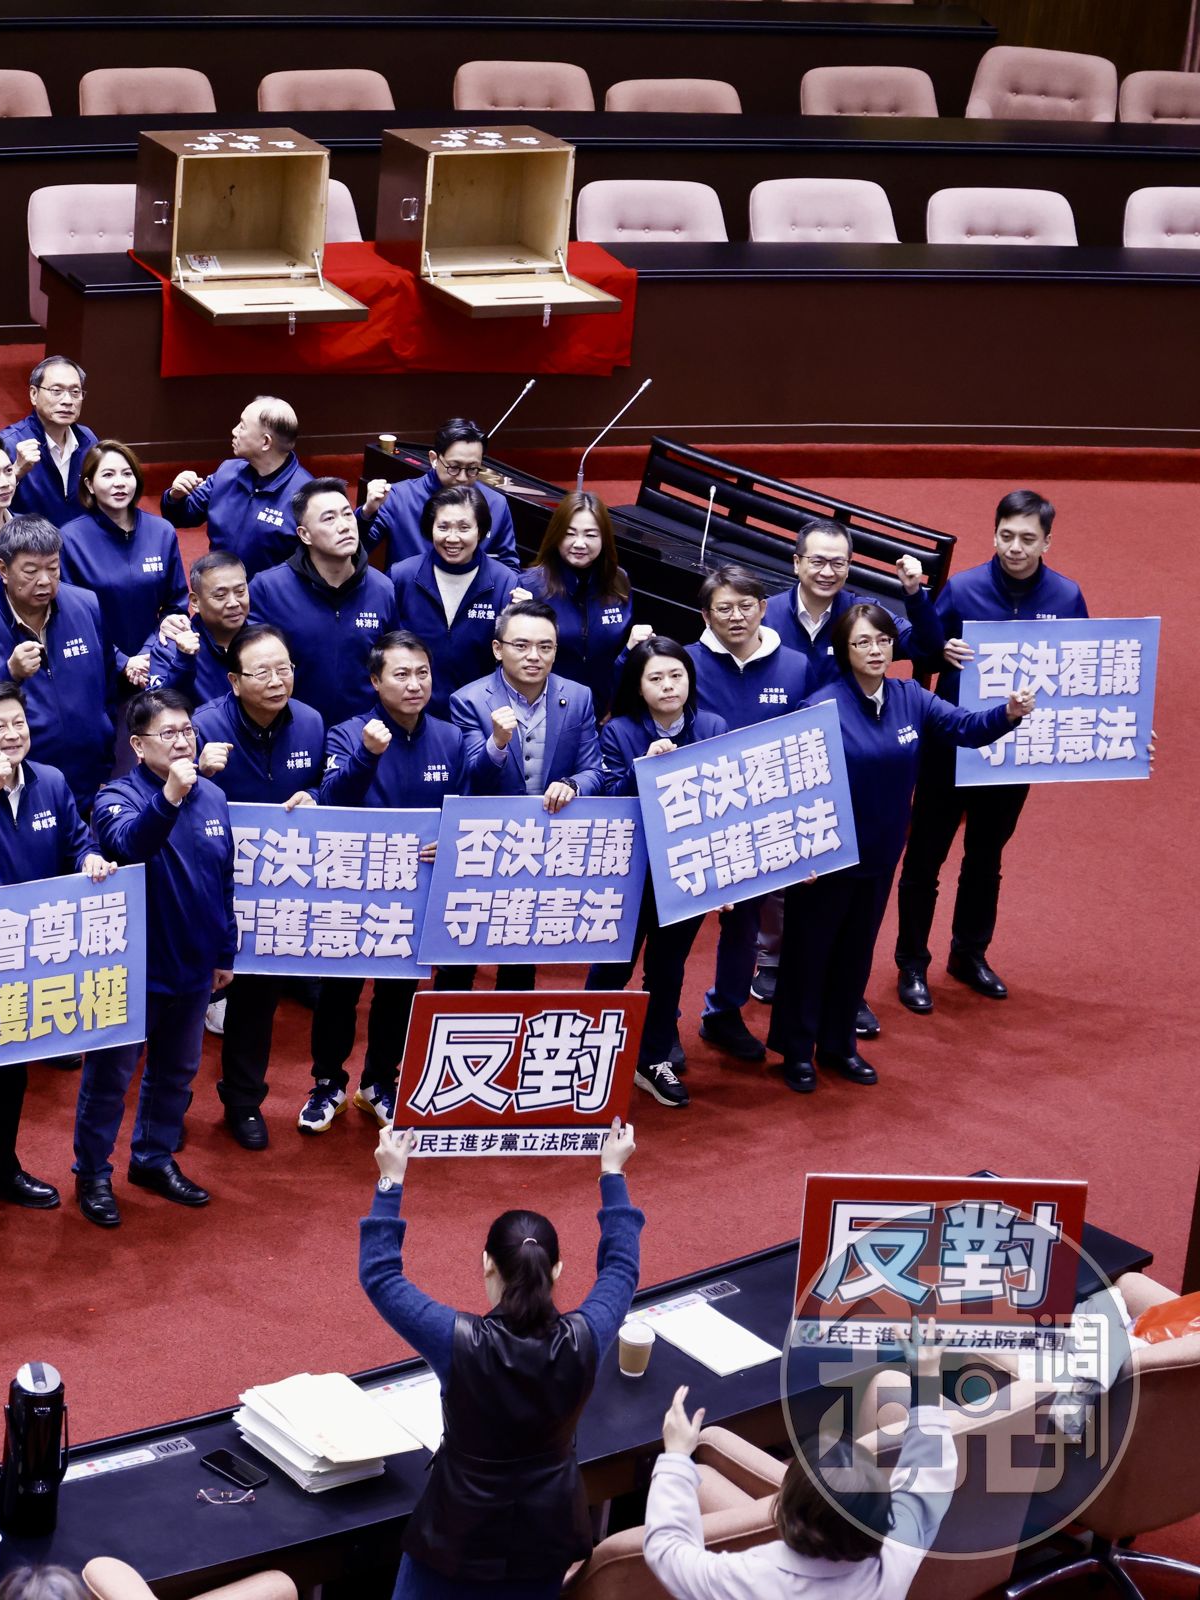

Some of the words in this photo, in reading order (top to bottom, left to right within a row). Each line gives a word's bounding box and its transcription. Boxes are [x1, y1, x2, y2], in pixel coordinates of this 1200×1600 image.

[467, 608, 495, 620] 徐欣瑩
[977, 639, 1142, 699] 否決覆議
[286, 757, 312, 769] 林德福
[656, 727, 832, 833] 否決覆議
[231, 827, 420, 891] 否決覆議
[455, 817, 635, 878] 否決覆議
[666, 798, 842, 897] 守護憲法
[443, 887, 625, 947] 守護憲法
[406, 1009, 627, 1116] 反對
[419, 1132, 620, 1153] 民主進步黨立法院黨
[810, 1199, 1063, 1307] 反對
[156, 1439, 189, 1454] 005
